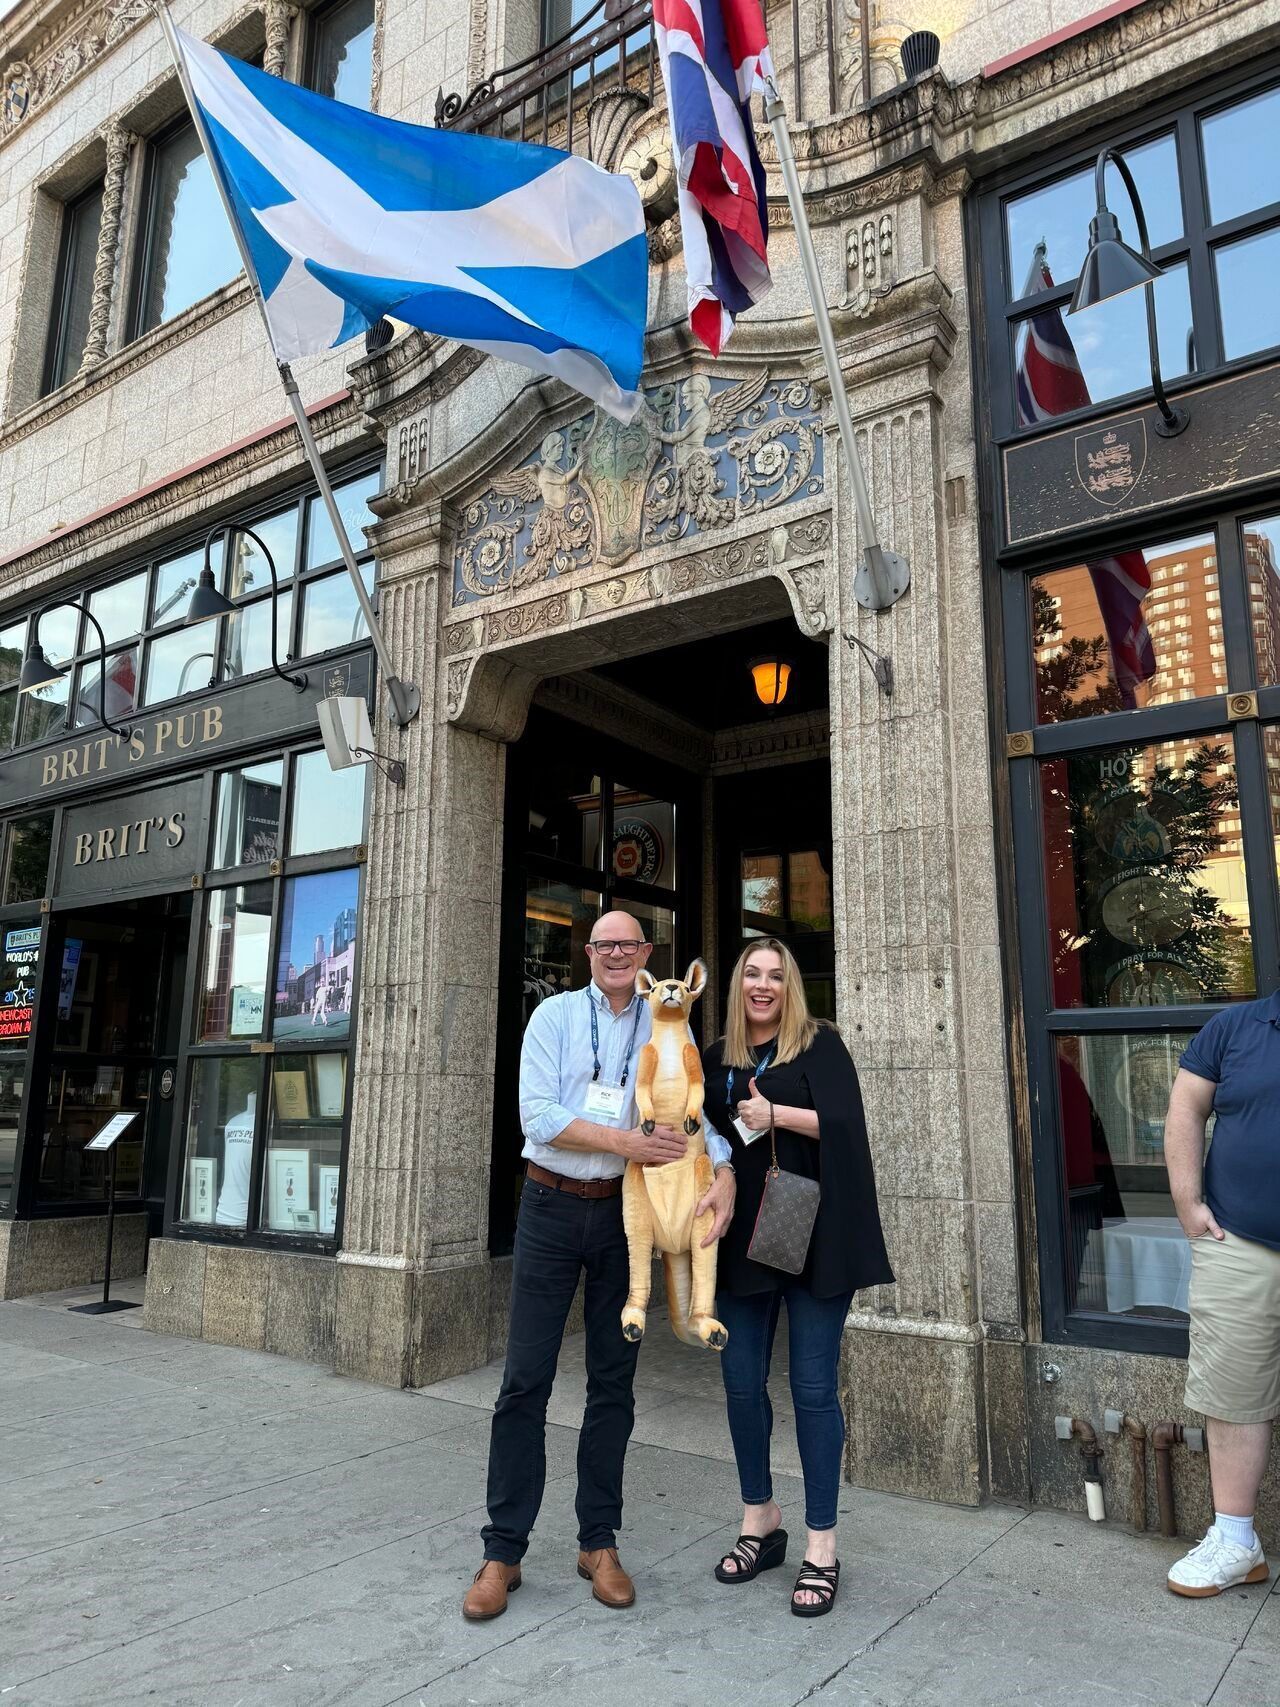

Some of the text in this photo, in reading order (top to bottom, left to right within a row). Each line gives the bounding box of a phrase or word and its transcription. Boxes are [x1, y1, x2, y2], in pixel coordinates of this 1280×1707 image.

[40, 705, 223, 787] BRIT'S PUB
[73, 811, 185, 867] BRIT'S
[641, 839, 656, 879] BEERS
[1117, 867, 1140, 882] FIGHT
[1122, 953, 1144, 966] PRAY
[16, 965, 30, 978] PUB
[1132, 1041, 1148, 1051] PAY
[1151, 1039, 1169, 1047] FOR
